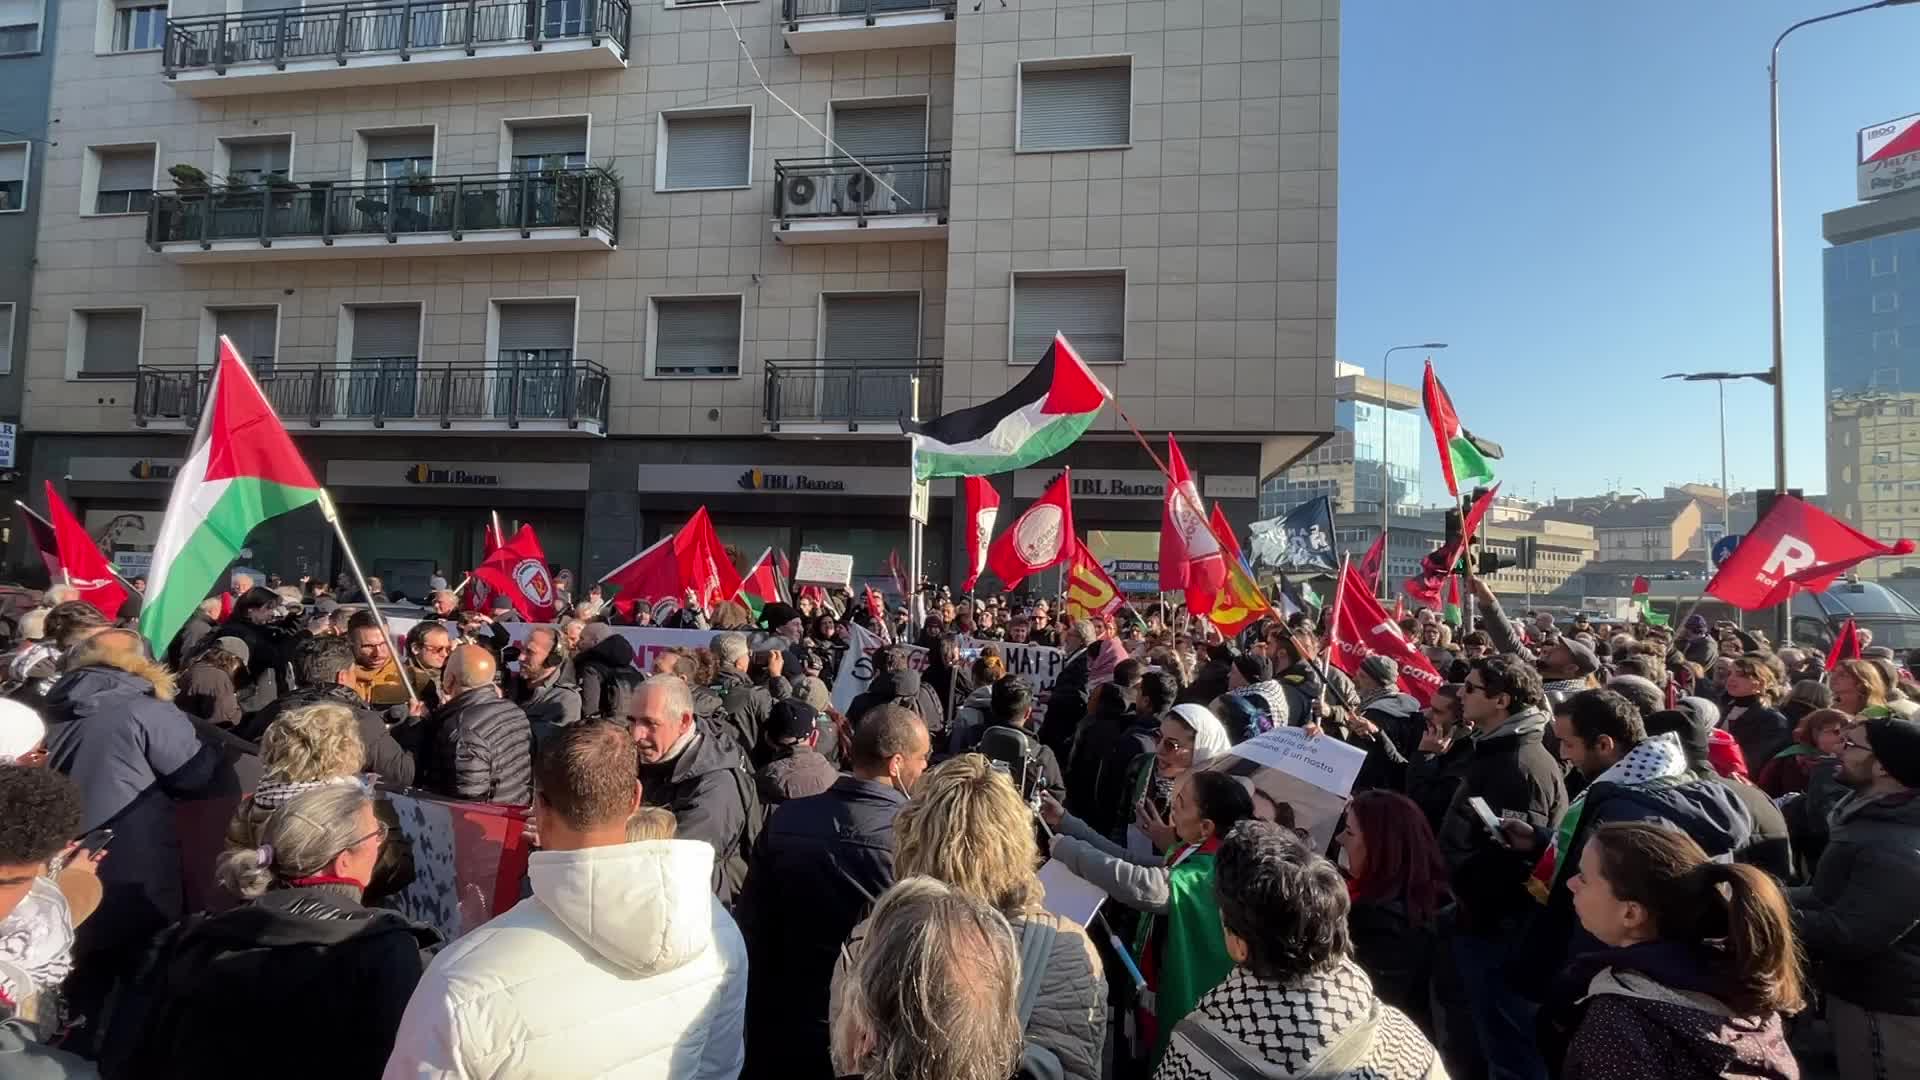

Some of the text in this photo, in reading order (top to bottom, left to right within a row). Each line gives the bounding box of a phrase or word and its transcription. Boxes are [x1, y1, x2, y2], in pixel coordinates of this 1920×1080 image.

[796, 474, 845, 490] Banca
[1073, 479, 1164, 496] IBL Banca
[1006, 646, 1040, 676] MAI
[1303, 756, 1334, 774] nostro
